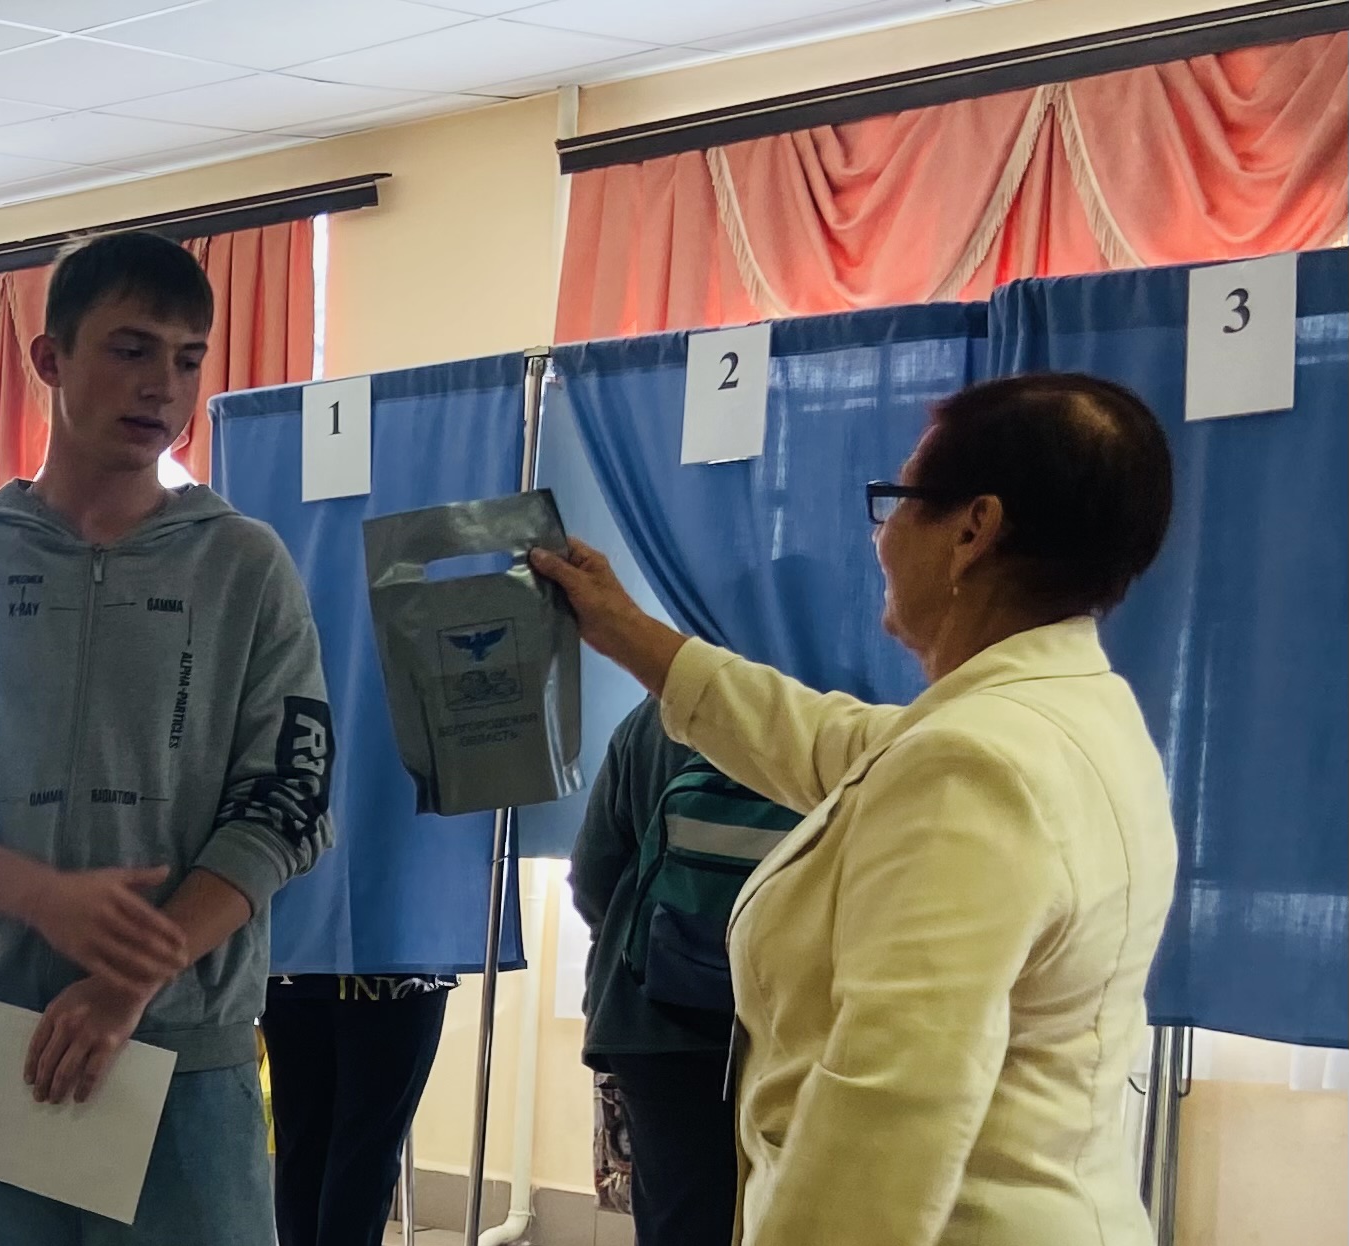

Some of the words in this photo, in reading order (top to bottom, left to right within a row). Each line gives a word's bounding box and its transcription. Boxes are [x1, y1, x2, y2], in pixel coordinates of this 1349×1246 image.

[1222, 287, 1251, 334] 3
[717, 351, 740, 391] 2
[328, 400, 342, 436] 1
[8, 602, 40, 617] X-RAY
[147, 597, 184, 613] GAMMA
[169, 651, 193, 749] ALPHA-PARTICLES
[29, 789, 64, 806] GAMMA
[91, 789, 137, 805] RADIATION
